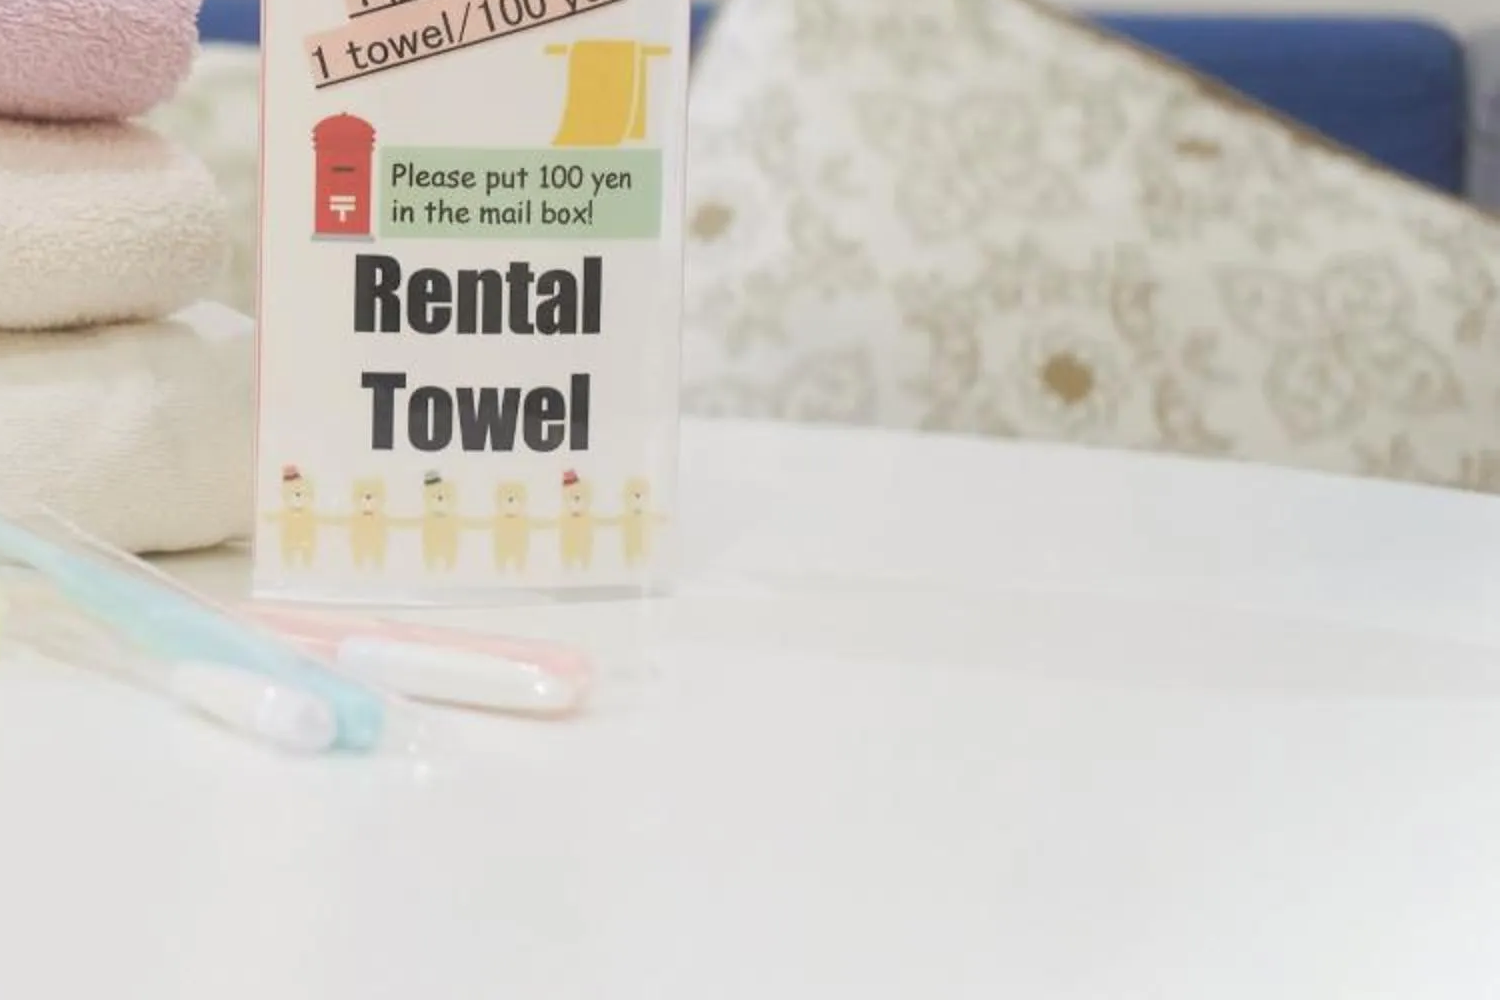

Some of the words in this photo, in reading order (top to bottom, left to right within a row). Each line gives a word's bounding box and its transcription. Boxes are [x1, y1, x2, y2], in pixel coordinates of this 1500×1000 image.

[311, 45, 330, 80] 1
[391, 163, 476, 189] Please
[486, 167, 528, 195] put
[539, 165, 583, 189] 100
[591, 170, 633, 196] yen
[391, 201, 414, 223] in
[425, 200, 469, 225] the
[479, 201, 531, 225] mail
[541, 200, 593, 225] box!
[354, 254, 603, 335] Rental
[361, 371, 591, 452] Towel
